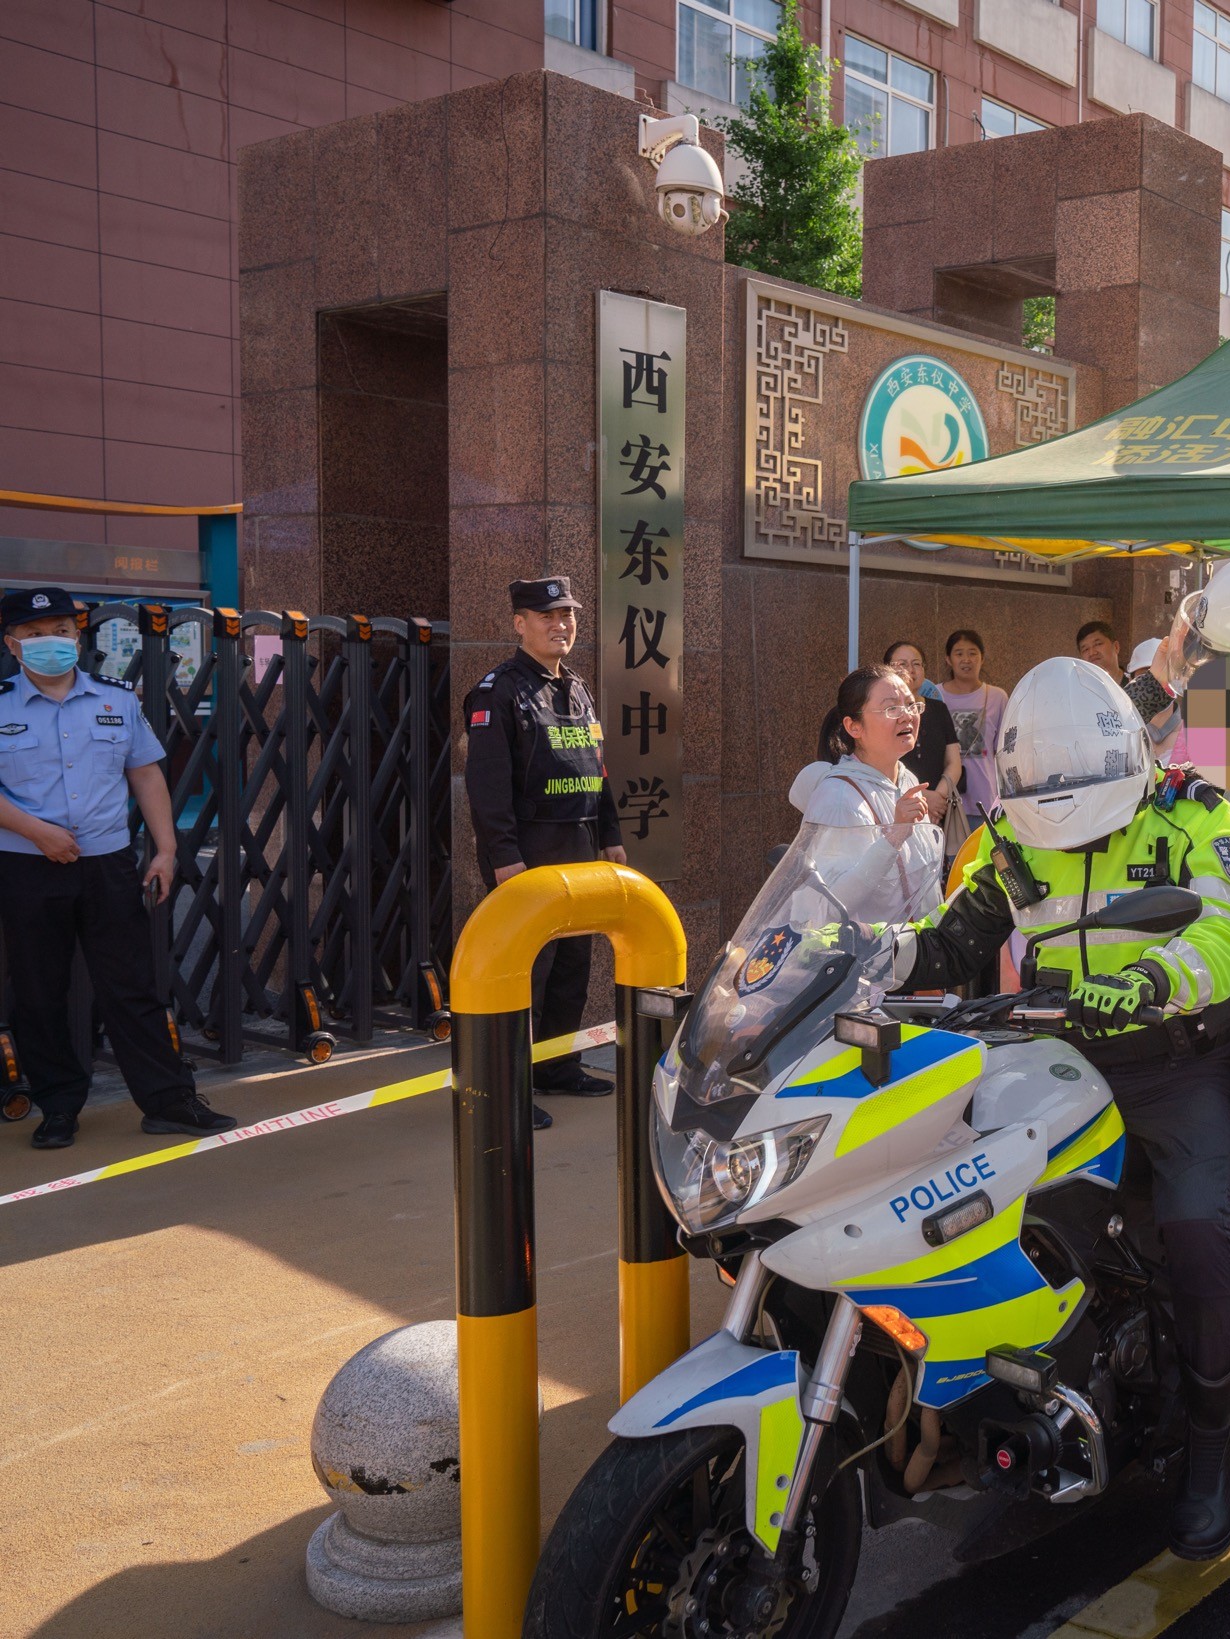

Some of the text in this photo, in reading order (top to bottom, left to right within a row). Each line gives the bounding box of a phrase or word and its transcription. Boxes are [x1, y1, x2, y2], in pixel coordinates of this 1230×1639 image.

[886, 363, 972, 414] 西安东仪中学
[114, 556, 160, 572] 阅报栏
[618, 347, 671, 840] 西安东仪中学
[889, 1153, 997, 1223] POLICE
